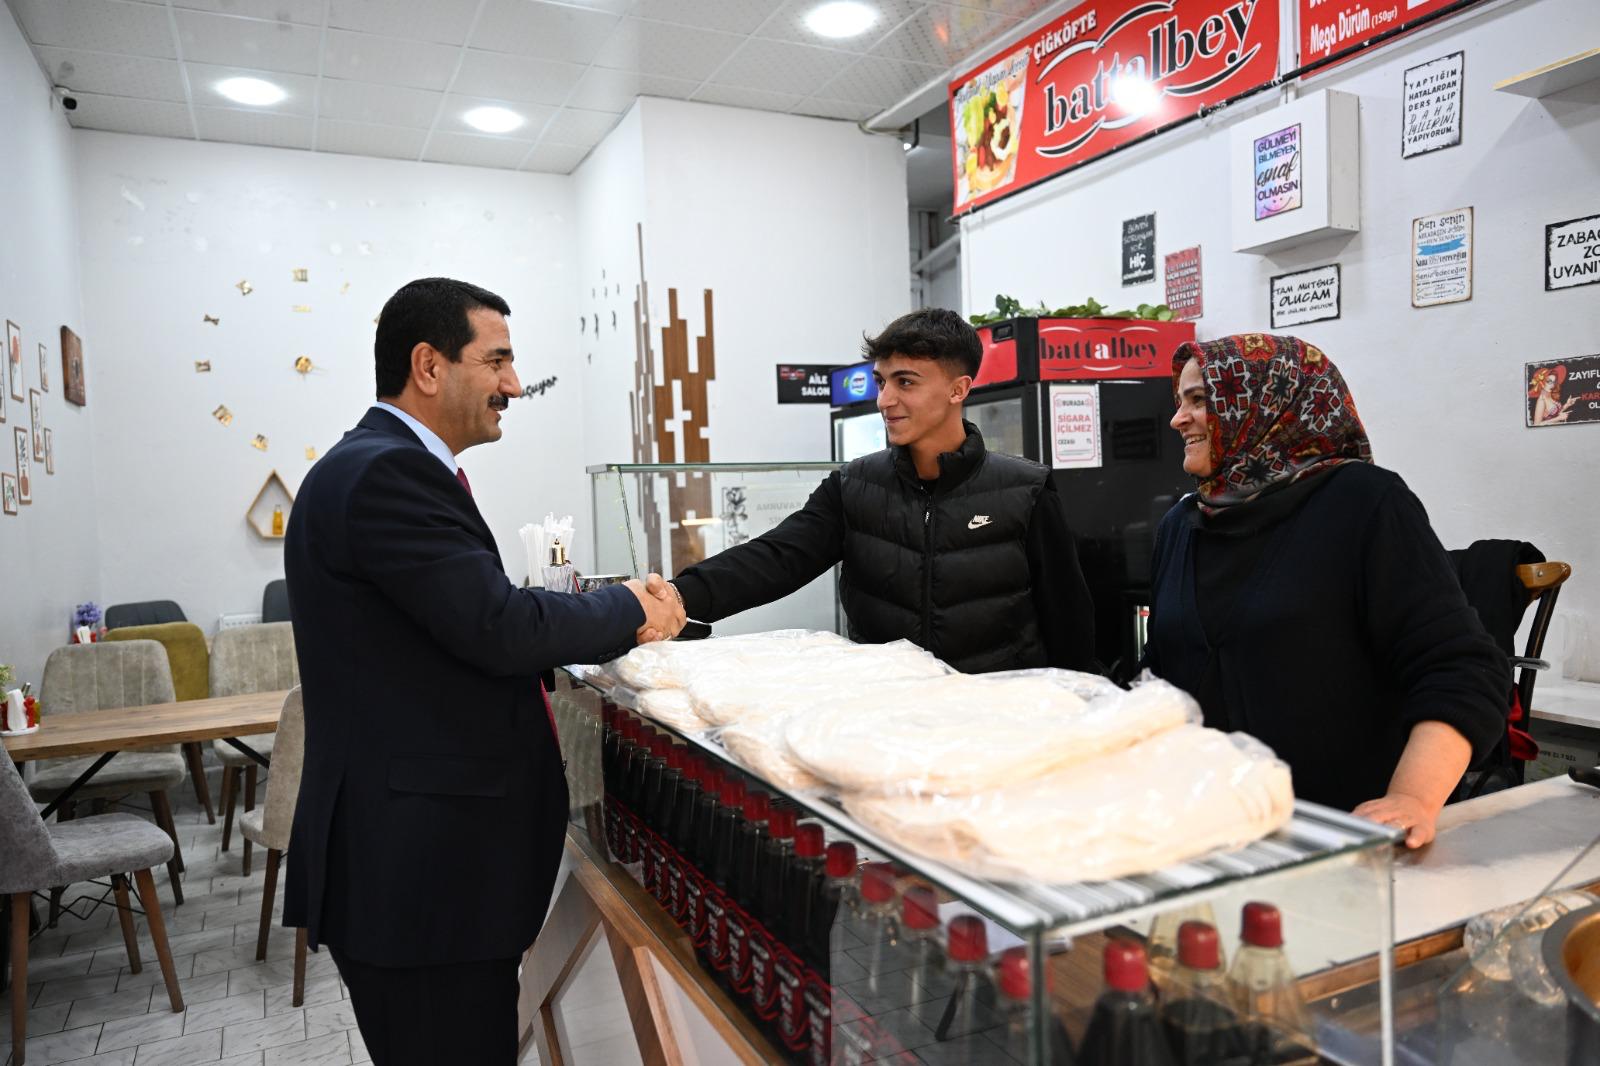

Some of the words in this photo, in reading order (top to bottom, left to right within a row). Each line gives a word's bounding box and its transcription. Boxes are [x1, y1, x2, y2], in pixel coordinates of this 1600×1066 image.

[1033, 8, 1098, 65] ÇİĞKÖFTE
[1310, 23, 1337, 56] Mega
[1339, 5, 1370, 42] Dürüm
[1371, 6, 1398, 29] (150gr)
[1409, 68, 1457, 90] YAPTIĞIM
[1408, 80, 1457, 101] HATALARDAN
[1408, 99, 1431, 112] DERS
[1435, 91, 1456, 104] ALIP
[1409, 102, 1454, 125] DAHA
[1258, 128, 1297, 153] GÜLMEYİ
[1258, 143, 1297, 164] BİLMEYEN
[1257, 150, 1300, 187] esnaf
[1257, 179, 1299, 201] OLMASIN
[1418, 221, 1436, 233] Ben
[1440, 213, 1465, 227] senin
[1129, 252, 1146, 269] HİÇ
[1553, 259, 1600, 279] UYANI
[1276, 285, 1293, 295] TAM
[1279, 288, 1331, 307] OLUCAM
[1040, 337, 1157, 365] battalbey
[808, 372, 828, 385] AİLE
[1058, 412, 1091, 423] SİGARA
[1057, 423, 1092, 434] İÇİLMEZ
